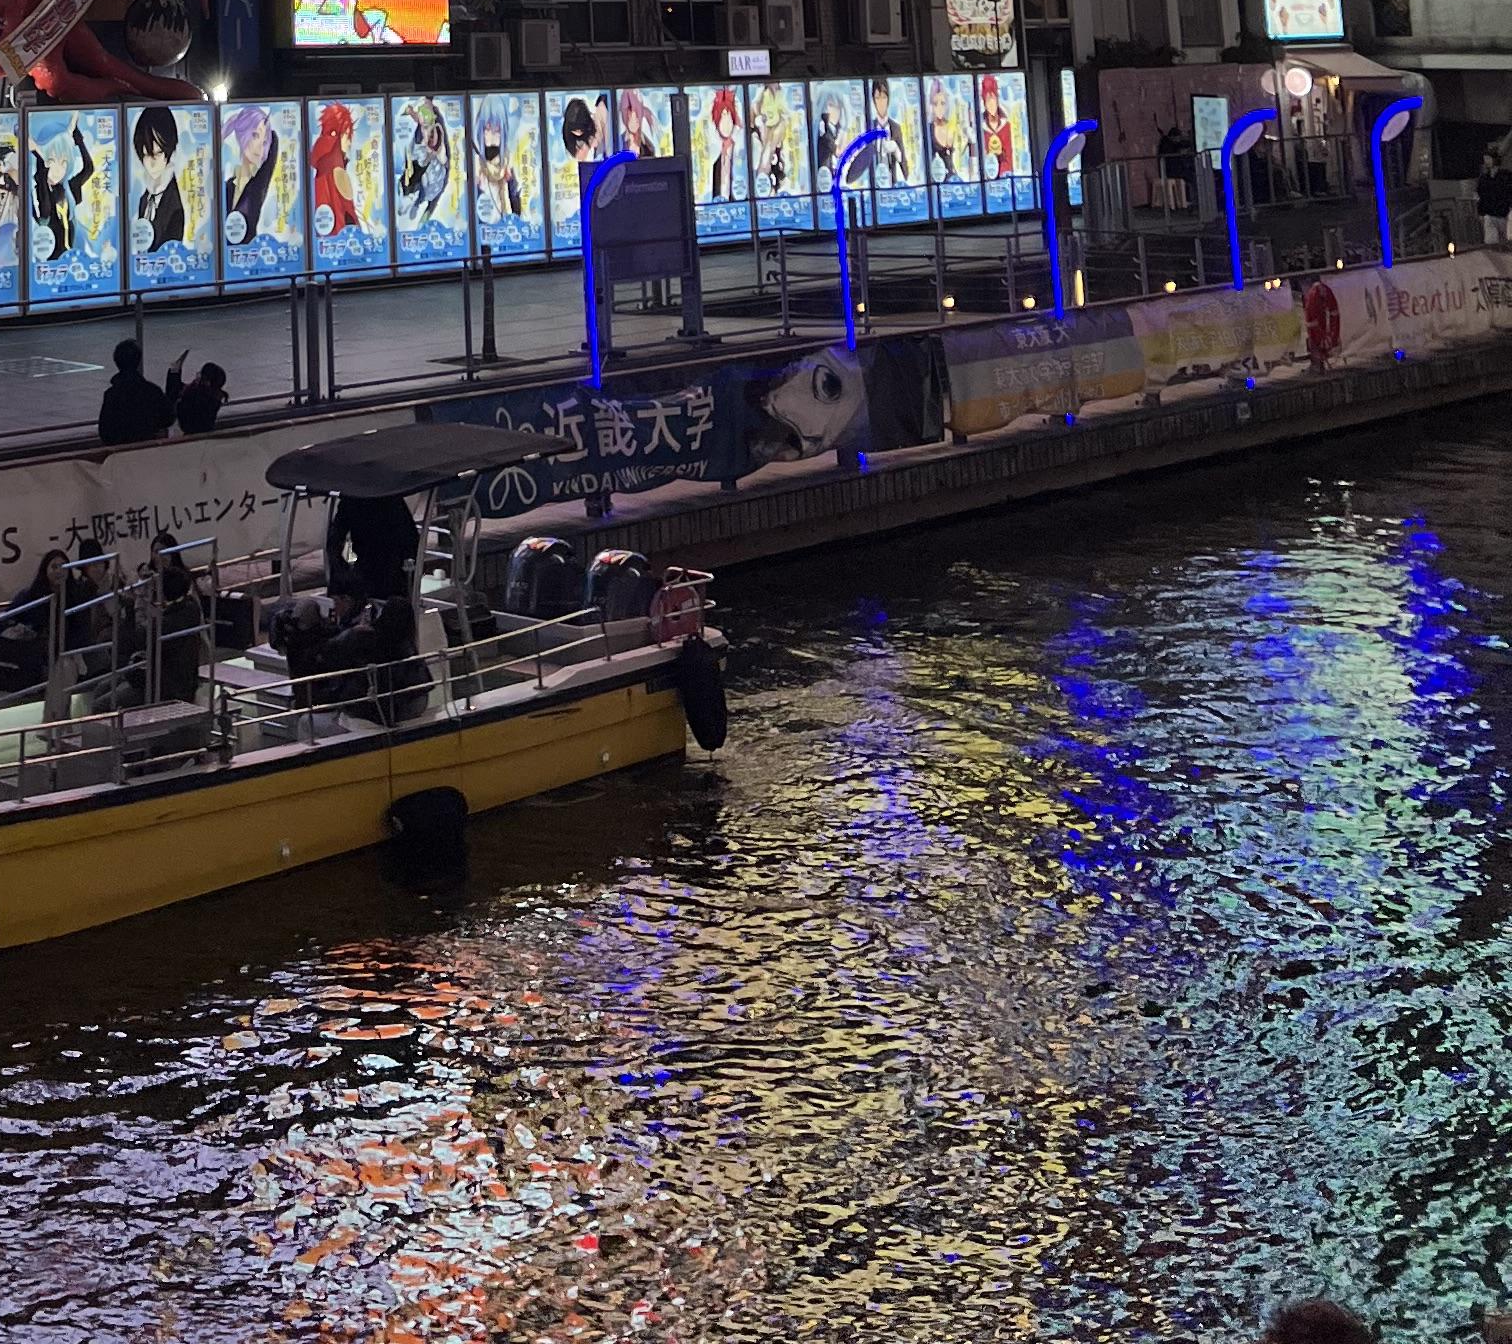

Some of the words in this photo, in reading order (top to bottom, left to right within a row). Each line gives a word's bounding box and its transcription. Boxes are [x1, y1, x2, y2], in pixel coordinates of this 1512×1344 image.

[730, 55, 752, 73] BAR
[541, 385, 715, 467] 近畿大学
